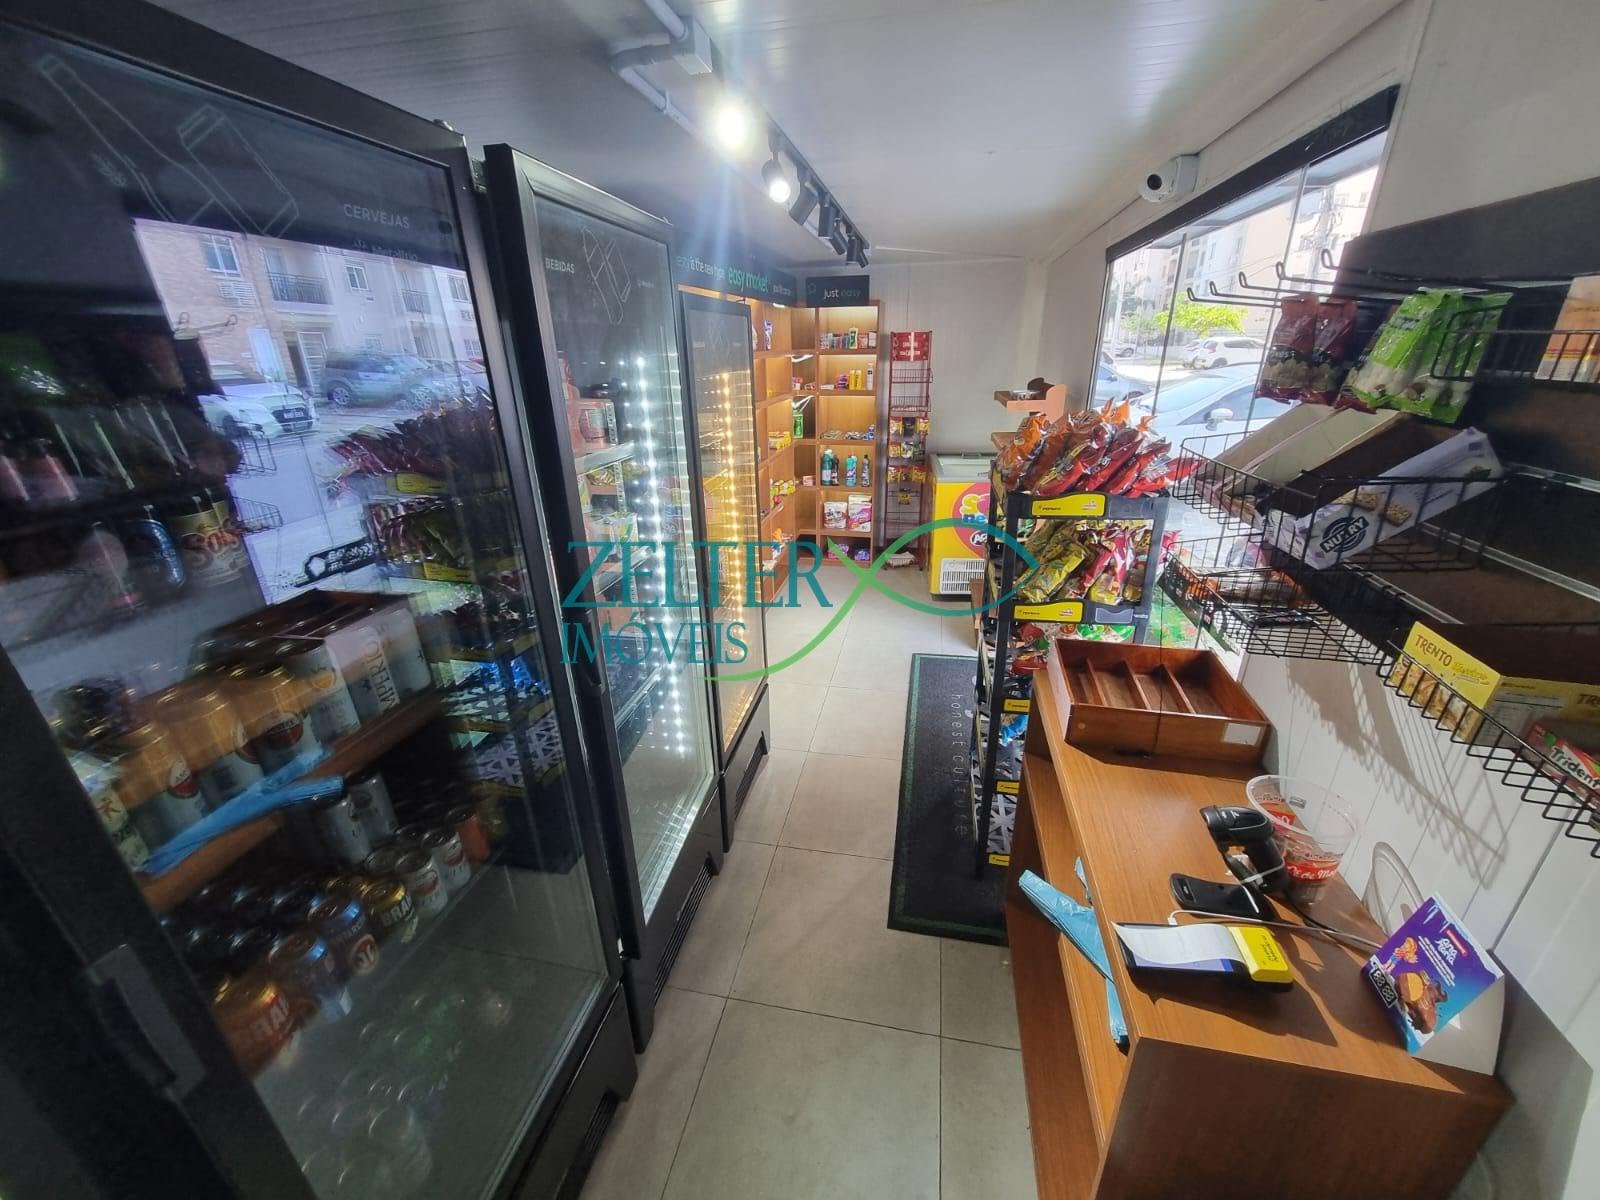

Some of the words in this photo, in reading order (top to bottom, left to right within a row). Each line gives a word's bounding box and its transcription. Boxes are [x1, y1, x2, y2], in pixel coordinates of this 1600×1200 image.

[343, 203, 410, 229] CERVEJAS
[545, 257, 575, 274] BEBIDAS
[728, 267, 745, 293] easy
[745, 272, 769, 293] market
[823, 287, 840, 300] just
[1414, 634, 1453, 668] TRENTO
[1550, 745, 1600, 789] Trident
